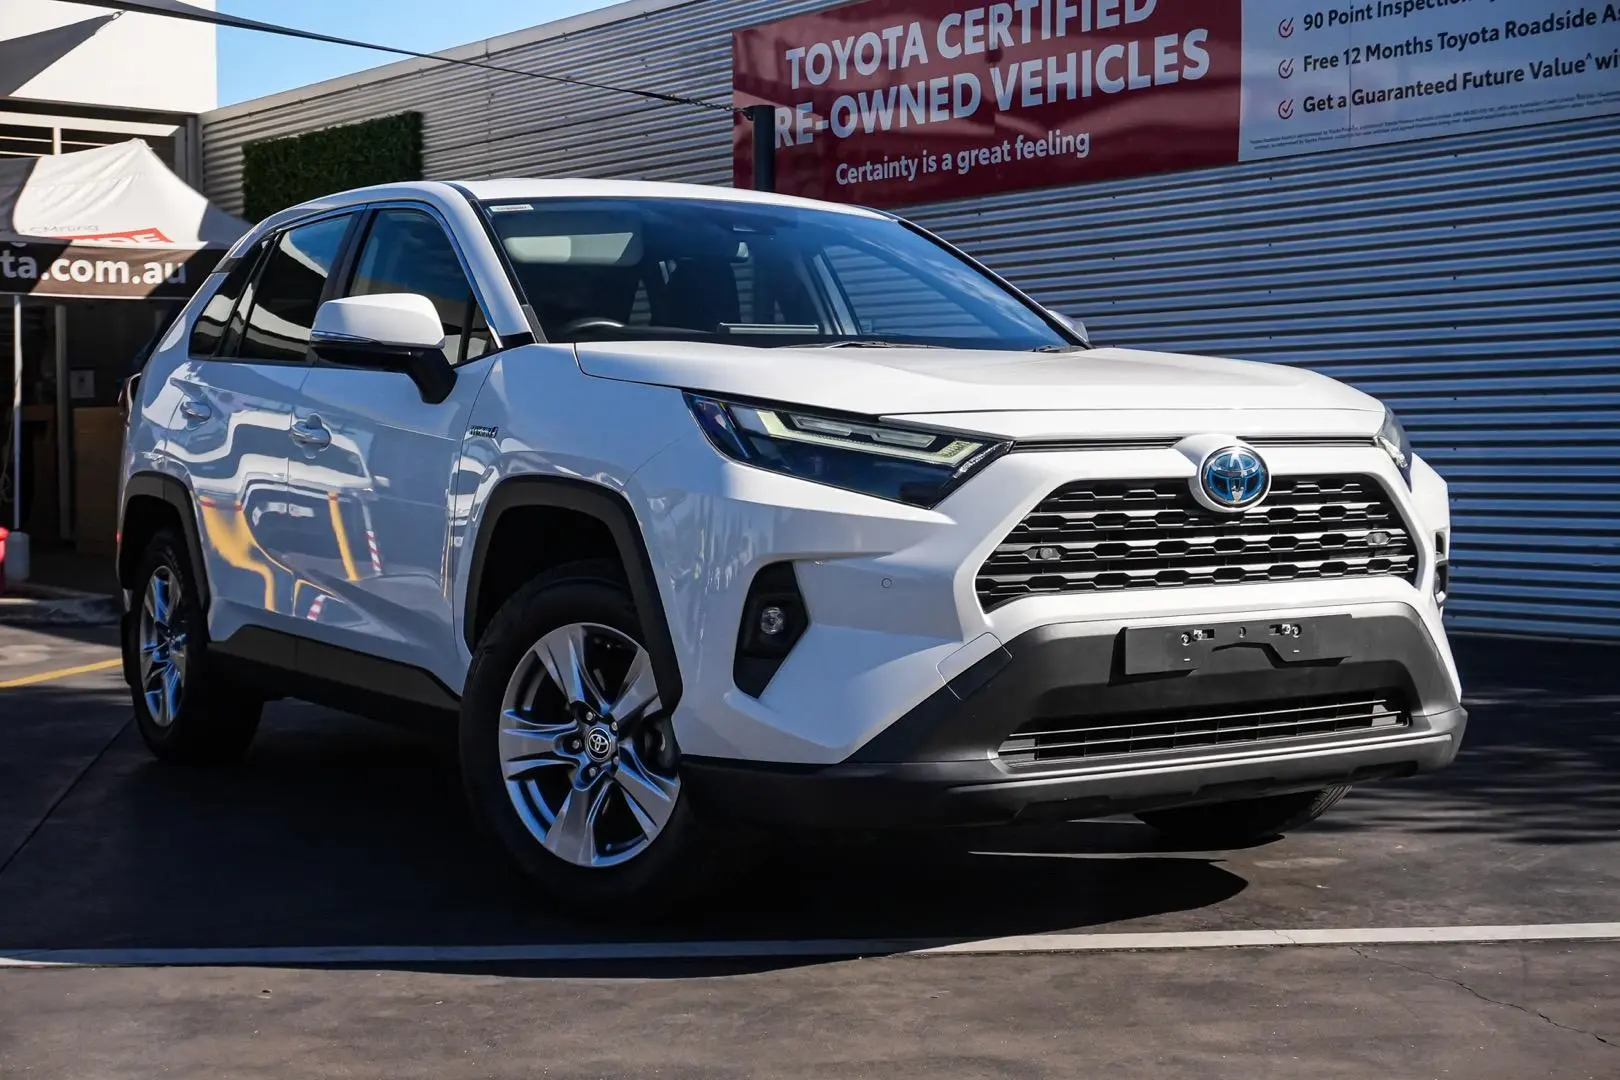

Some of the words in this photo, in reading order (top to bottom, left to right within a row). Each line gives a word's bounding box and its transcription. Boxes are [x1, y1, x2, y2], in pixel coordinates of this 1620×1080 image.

[1303, 12, 1324, 31] 90
[1328, 4, 1373, 27] Point
[1303, 54, 1339, 72] Free
[1343, 46, 1361, 66] 12
[1365, 36, 1434, 62] Months
[1437, 26, 1500, 52] Toyota
[1505, 8, 1597, 39] Roadside
[785, 21, 929, 90] TOYOTA
[1303, 94, 1334, 113] Get
[1337, 95, 1347, 109] a
[1351, 73, 1458, 106] Guaranteed
[1462, 69, 1525, 90] Future
[1594, 48, 1620, 70] wi
[774, 72, 982, 149] RE-OWNED
[989, 28, 1210, 112] VEHICLES
[835, 155, 918, 186] Certainty
[922, 150, 937, 174] is
[941, 152, 953, 170] a
[957, 139, 1011, 175] great
[1015, 128, 1090, 160] feeling
